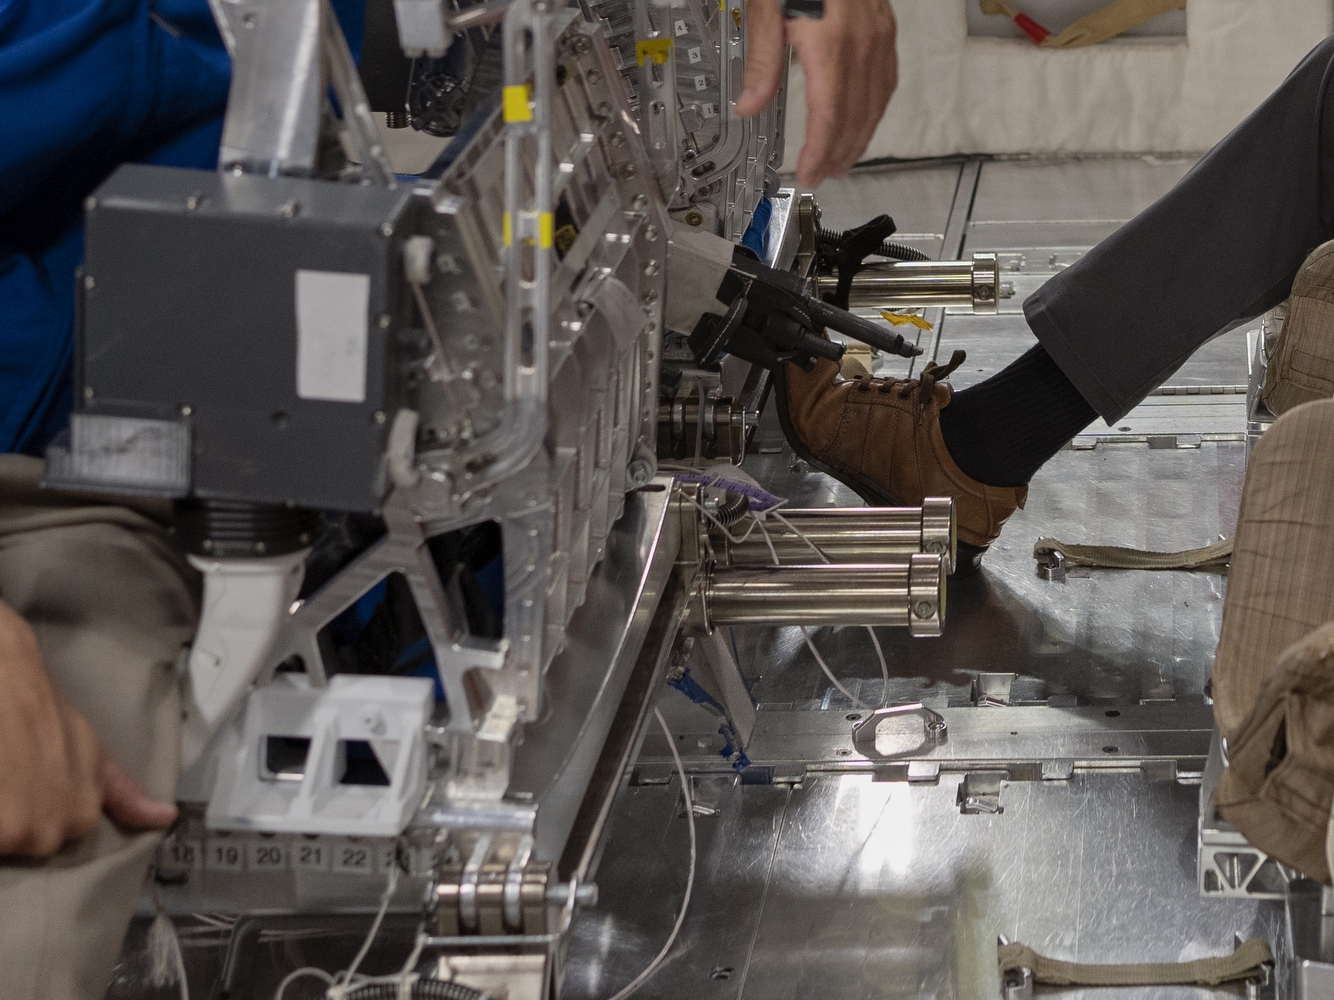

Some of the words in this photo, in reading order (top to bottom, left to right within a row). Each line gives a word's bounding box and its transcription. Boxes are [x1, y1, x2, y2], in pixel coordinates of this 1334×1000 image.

[217, 846, 238, 864] 19
[257, 845, 281, 864] 20
[300, 846, 321, 863] 21
[343, 849, 366, 867] 22
